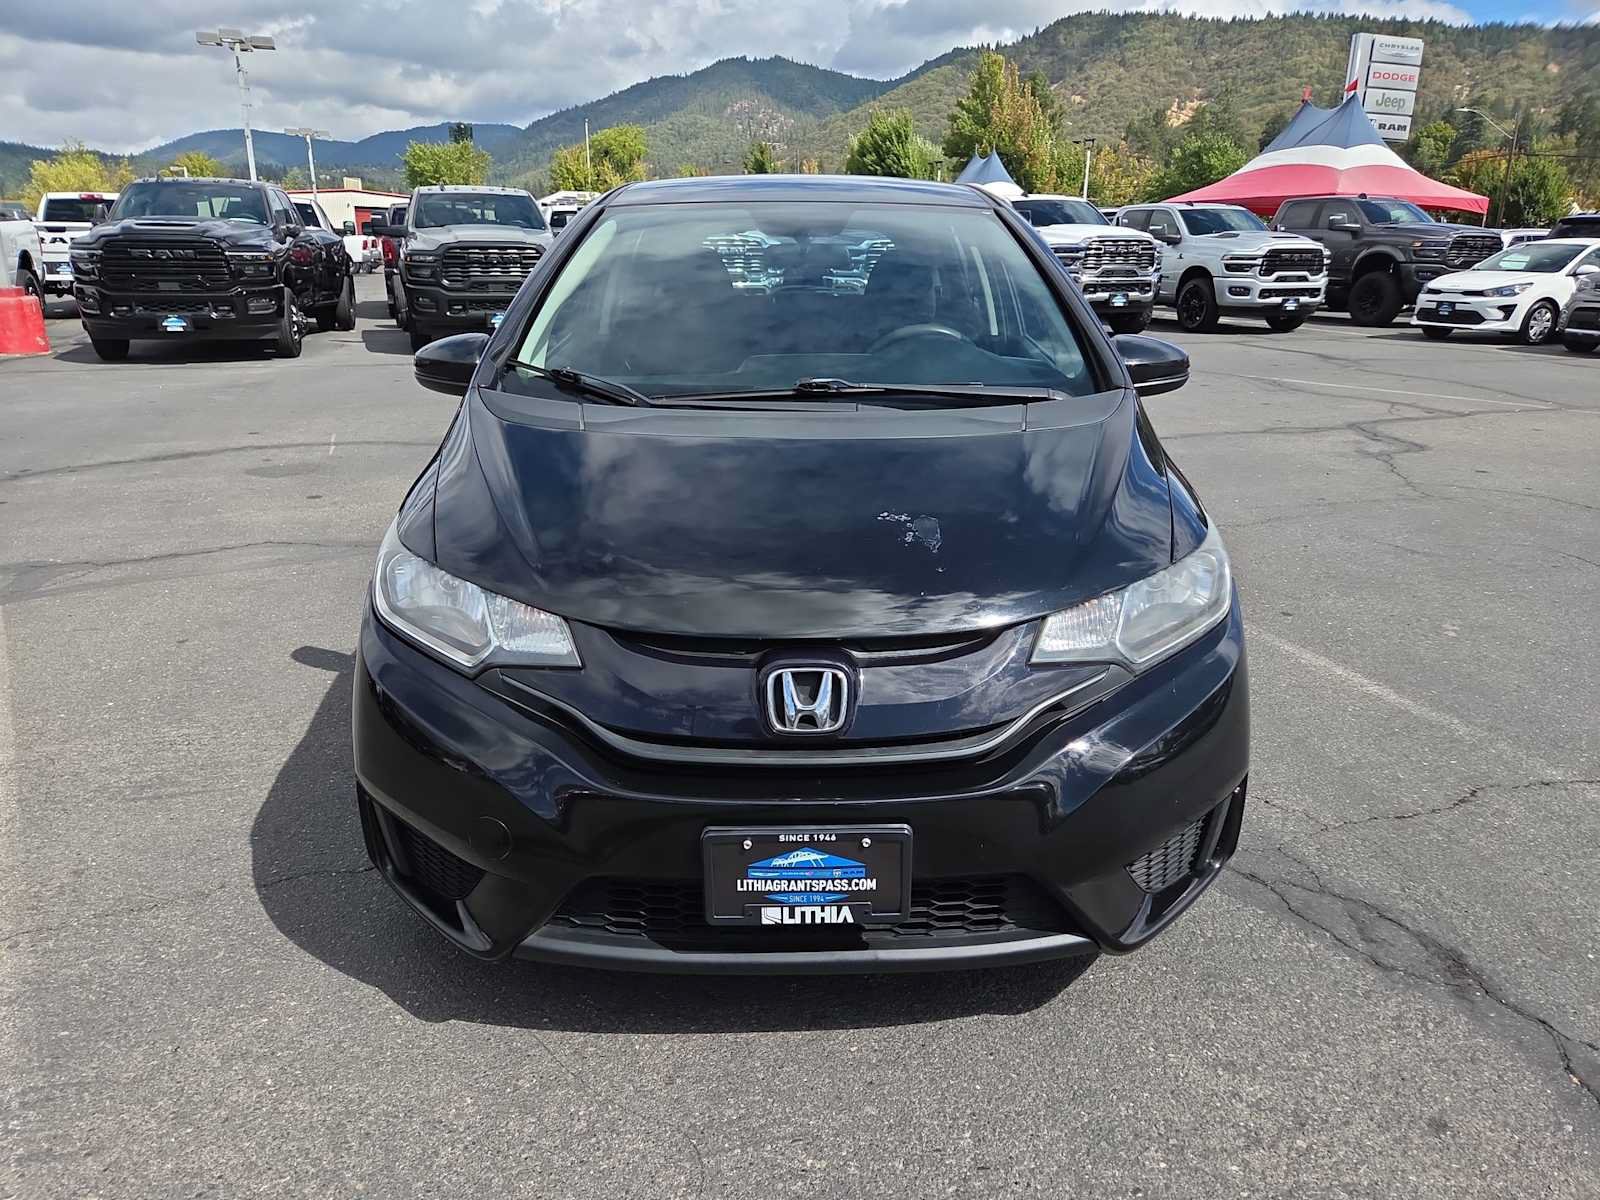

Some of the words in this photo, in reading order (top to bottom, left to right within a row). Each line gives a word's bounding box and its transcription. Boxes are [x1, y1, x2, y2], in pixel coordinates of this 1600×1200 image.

[1379, 42, 1420, 51] CHRYSLER
[1372, 71, 1416, 82] DODGE
[1375, 92, 1406, 111] Jeep
[1378, 123, 1407, 132] RAM
[130, 249, 195, 259] RAM
[778, 834, 810, 842] SINCE
[737, 878, 877, 892] LITHIAGRANTSPASS.COM
[789, 895, 807, 903] SINCE
[782, 905, 855, 924] LITHIA
